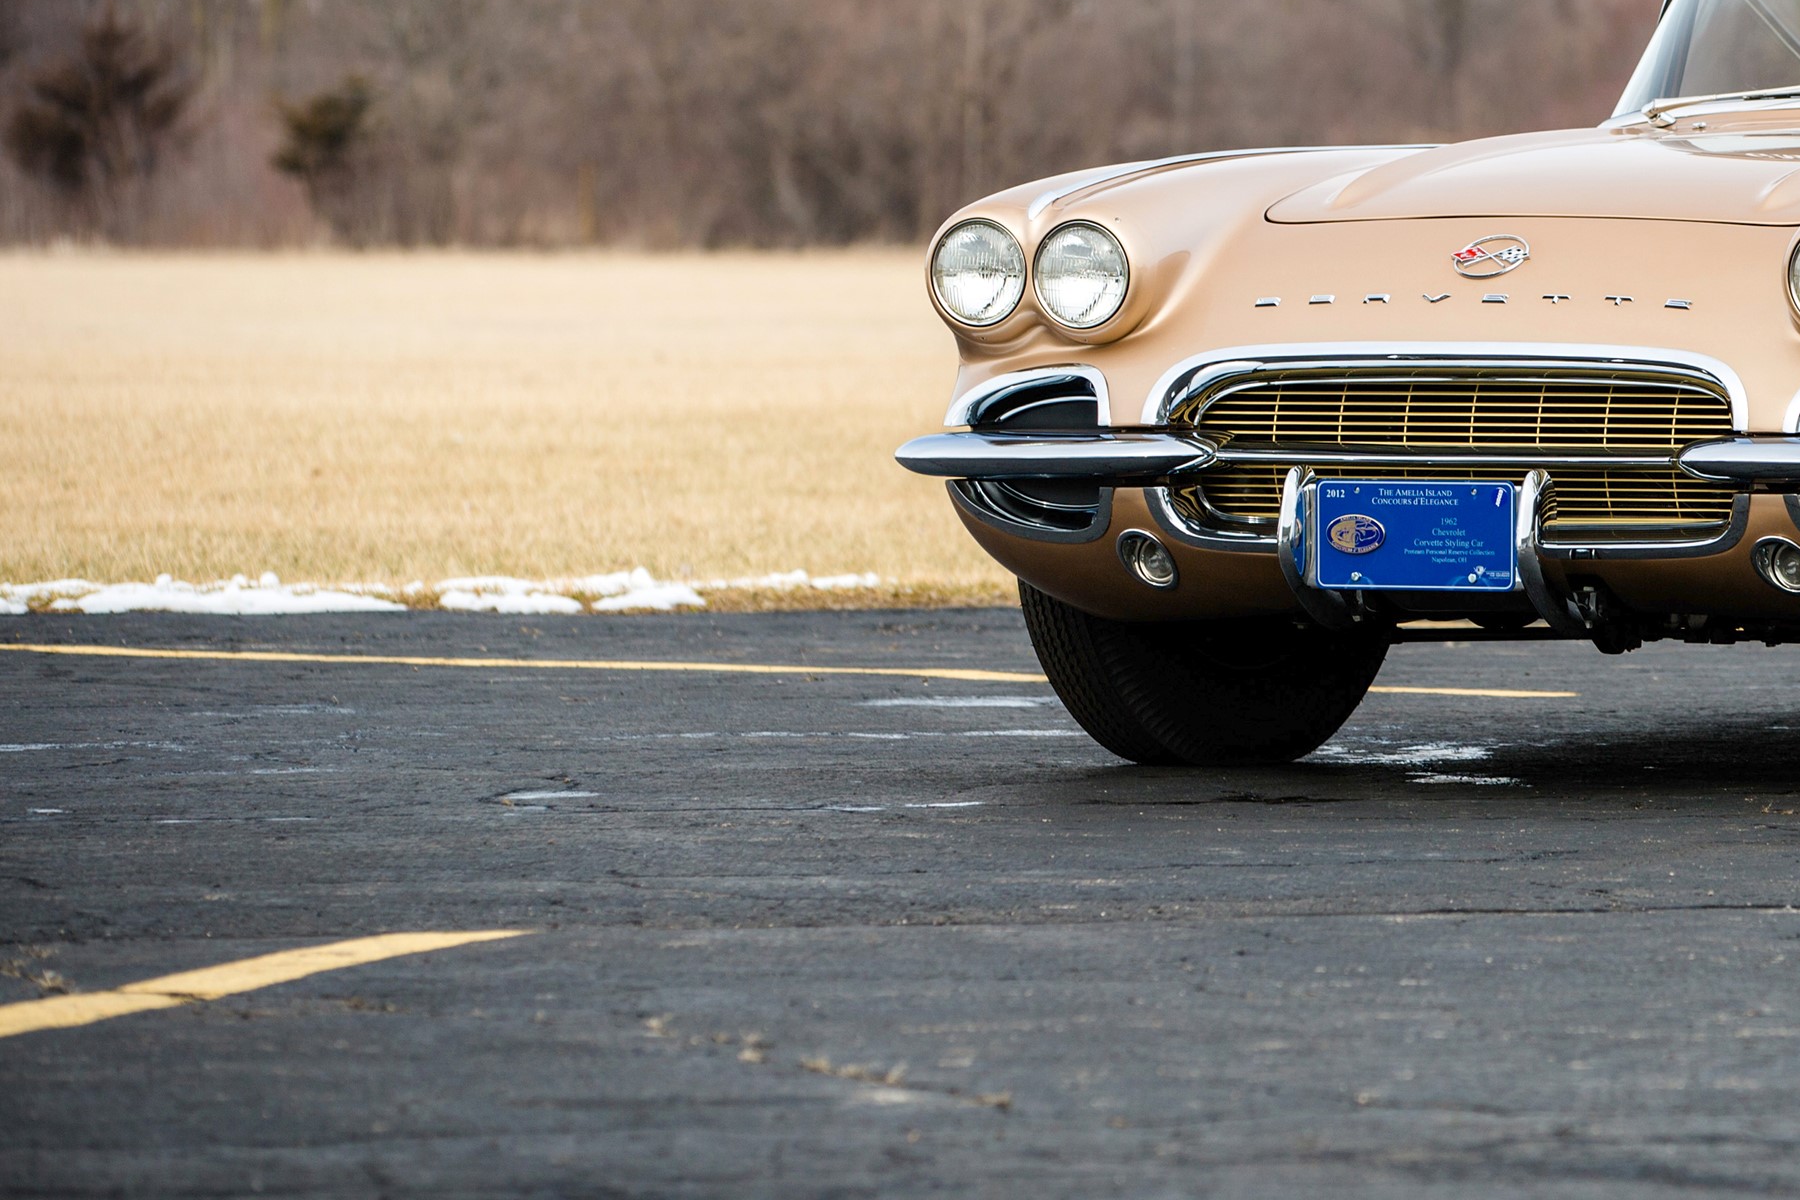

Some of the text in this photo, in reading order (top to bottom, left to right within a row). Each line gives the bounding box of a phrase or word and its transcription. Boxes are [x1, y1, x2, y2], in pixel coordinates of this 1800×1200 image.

[1326, 489, 1346, 498] 2012
[1378, 488, 1453, 497] THE AMELIA ISLAND
[1371, 497, 1412, 505] CONCOURS
[1440, 517, 1458, 526] 1962
[1431, 528, 1466, 537] Chevrolet
[1413, 538, 1484, 549] Corvette Styling Car
[1448, 548, 1468, 556] Reserve
